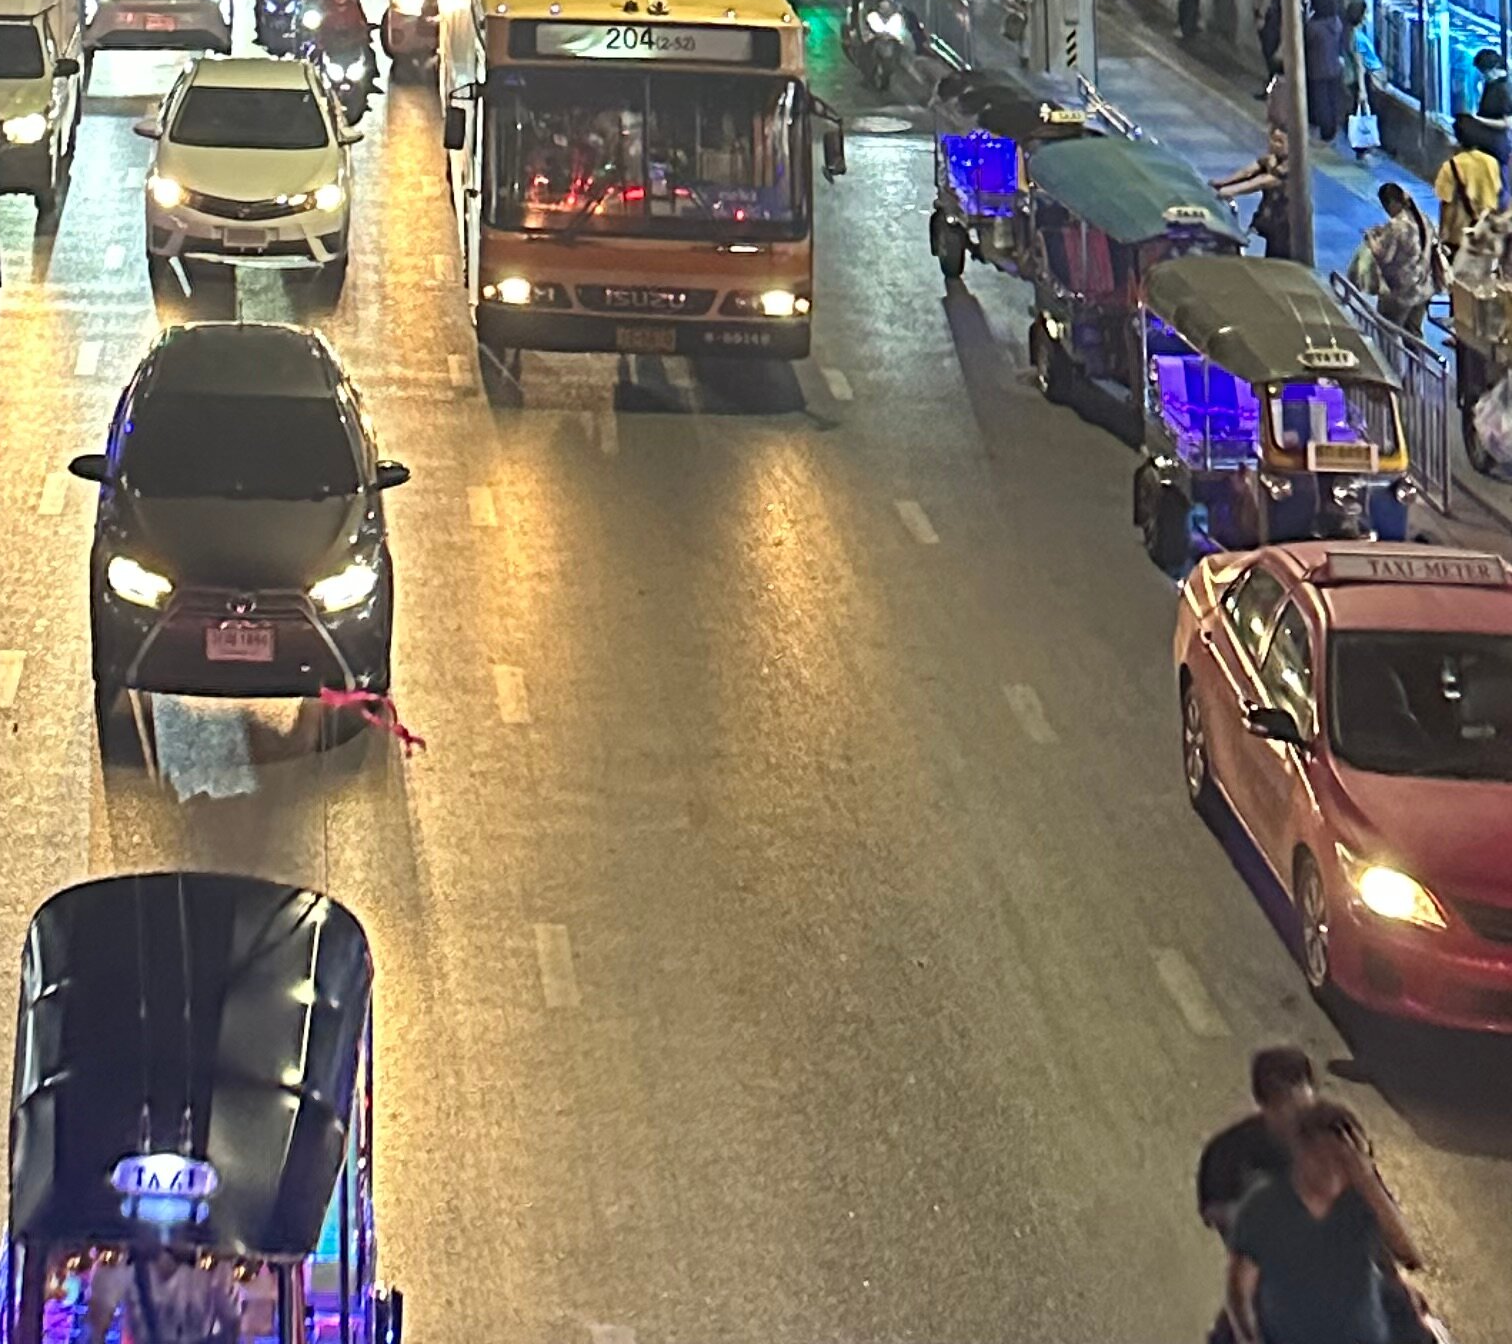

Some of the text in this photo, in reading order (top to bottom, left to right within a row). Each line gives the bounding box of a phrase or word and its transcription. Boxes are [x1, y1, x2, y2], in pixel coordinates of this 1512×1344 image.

[606, 27, 655, 50] 204
[604, 288, 686, 308] ISUZU
[1367, 559, 1492, 579] TAXI-METER
